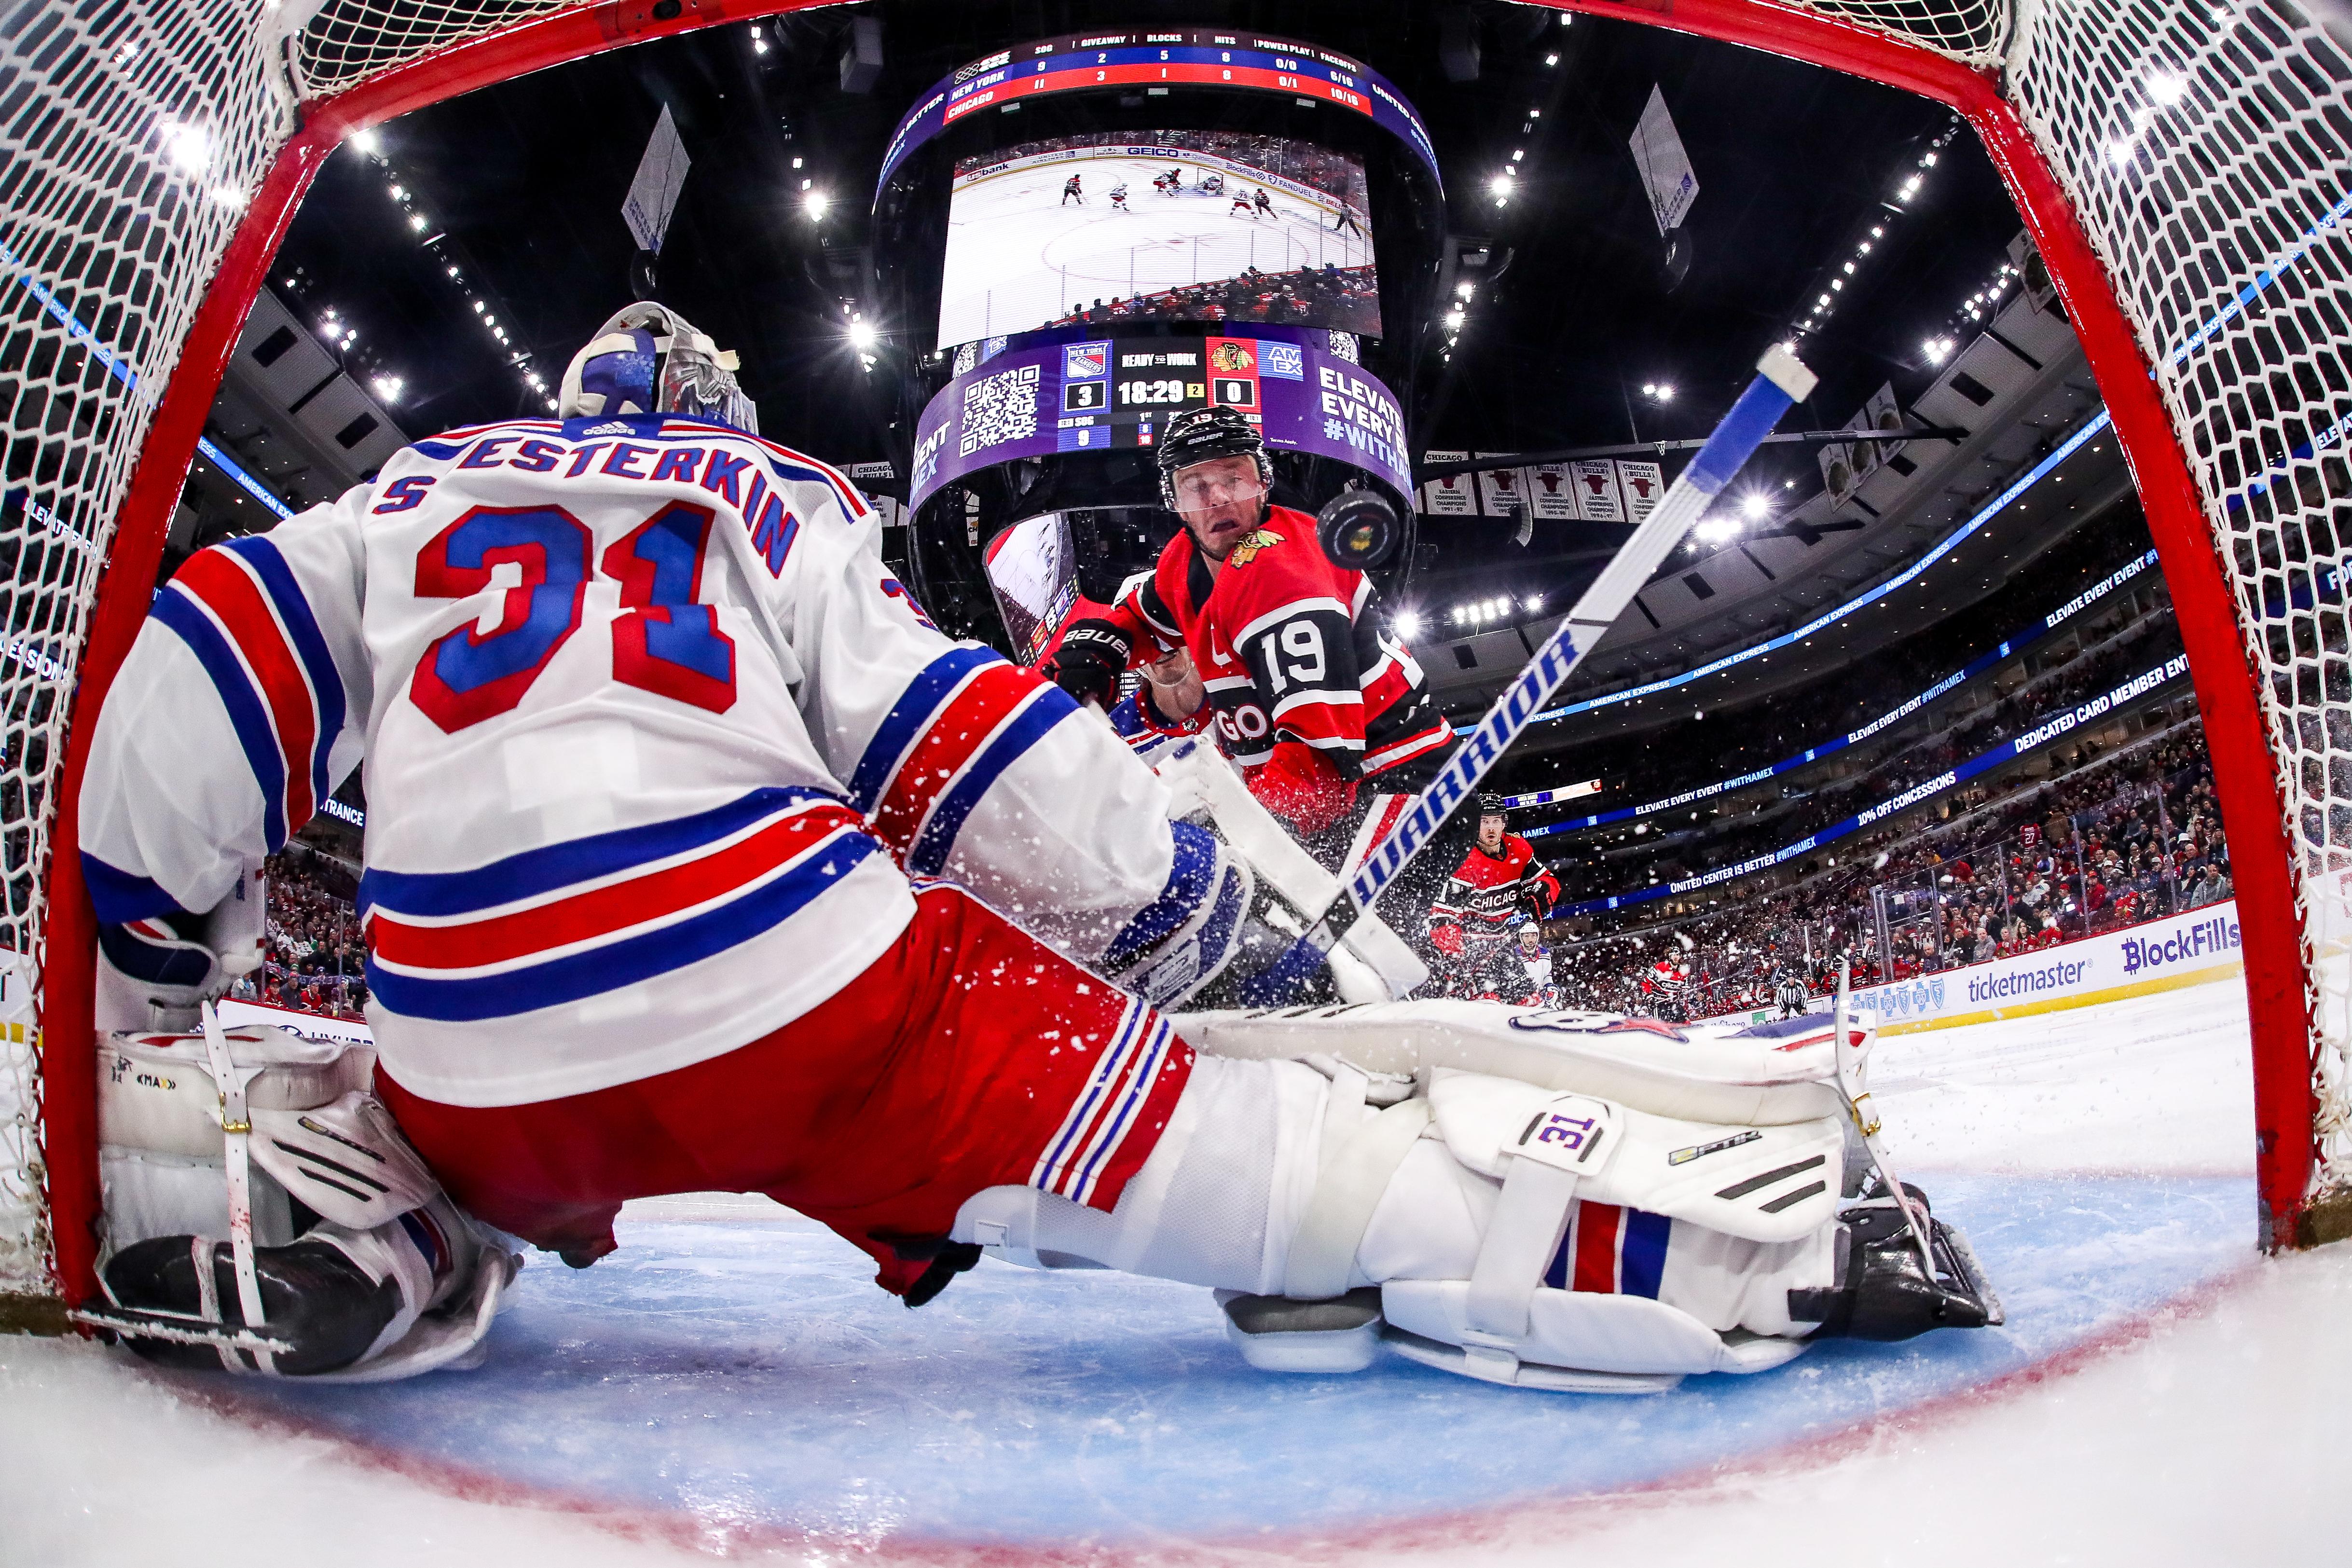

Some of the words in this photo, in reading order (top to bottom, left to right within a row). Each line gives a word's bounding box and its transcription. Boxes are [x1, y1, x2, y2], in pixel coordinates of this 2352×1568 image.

[1034, 44, 1053, 54] SOG
[1081, 36, 1126, 47] GIVEAWAY
[1146, 34, 1182, 42] BLOCKS
[1214, 36, 1237, 45] HITS
[1258, 40, 1288, 52] POWER
[1289, 45, 1310, 56] PLAY
[1320, 52, 1357, 73] FACEOFFS
[948, 91, 994, 119] CHICAGO
[1034, 78, 1045, 90] 11
[1097, 70, 1106, 81] 3
[1161, 68, 1167, 78] 1
[1222, 70, 1232, 81] 8
[1279, 76, 1298, 88] 0/1
[1330, 87, 1359, 106] 10/16
[951, 81, 974, 101] NEW
[976, 70, 1006, 89] YORK
[1037, 61, 1046, 71] 9
[1098, 53, 1106, 63] 2
[1160, 50, 1169, 60] 5
[1221, 52, 1230, 62] 8
[1275, 58, 1297, 71] 0/0
[1330, 70, 1354, 87] 6/16
[906, 93, 945, 132] BETTER
[1372, 83, 1410, 119] UNITED
[1128, 147, 1179, 158] GEICO
[1279, 180, 1313, 198] FANDUEL
[1122, 353, 1155, 368] READY
[1167, 353, 1197, 366] WORK
[1078, 385, 1093, 406] 3
[1118, 379, 1184, 404] 18:29
[1193, 385, 1198, 395] 2
[1226, 381, 1242, 402] 0
[582, 426, 636, 436] adidas
[1192, 413, 1213, 425] 19
[1321, 391, 1393, 444] EVERY
[1077, 430, 1090, 447] 9
[2056, 423, 2097, 461] AMERICAN
[857, 465, 893, 474] CHICAGO
[1622, 463, 1655, 472] CHICAGO
[237, 473, 278, 511] AMERICAN
[372, 434, 800, 579] SESTERKIN
[1967, 498, 2003, 533] AMERICAN
[2001, 472, 2036, 507] EXPRESS
[1884, 560, 1922, 592] AMERICAN
[1921, 541, 1950, 568] EXPRESS
[2046, 596, 2084, 628] ELEVATE
[2083, 578, 2114, 604] EVERY
[2113, 556, 2146, 587] EVENT
[410, 498, 737, 735] 31
[1793, 610, 1831, 640] AMERICAN
[1830, 597, 1864, 621] EXPRESS
[1261, 619, 1326, 695] 19
[1692, 658, 1732, 678] AMERICAN
[1733, 643, 1770, 662] EXPRESS
[1589, 690, 1631, 708] AMERICAN
[1632, 679, 1670, 697] EXPRESS
[1847, 720, 1880, 744] ELEVATE
[1878, 707, 1900, 729] EVERY
[1898, 695, 1922, 718] EVENT
[1921, 670, 1967, 705] #WITHAMEX
[2014, 710, 2076, 754] DEDICATED
[2076, 694, 2110, 724] CARD
[2111, 667, 2165, 707] MEMBER
[1528, 708, 1566, 723] EXPRESS
[1352, 629, 1581, 908] WARRIOR
[1635, 798, 1670, 815] ELEVATE
[1670, 792, 1695, 806] EVERY
[1696, 783, 1723, 798] EVENT
[1723, 767, 1774, 790] #WITHAMEX
[1857, 807, 1877, 827] 10%
[1876, 798, 1893, 819] OFF
[1892, 770, 1957, 811] CONCESSIONS
[1669, 877, 1703, 894] UNITED
[1702, 867, 1734, 886] CENTER
[1733, 864, 1744, 877] IS
[1743, 854, 1776, 874] BETTER
[1775, 836, 1817, 863] #WITHAMEX
[1471, 890, 1517, 909] CHICAG
[2121, 917, 2241, 975] BlockFills
[1537, 1114, 1596, 1151] 31
